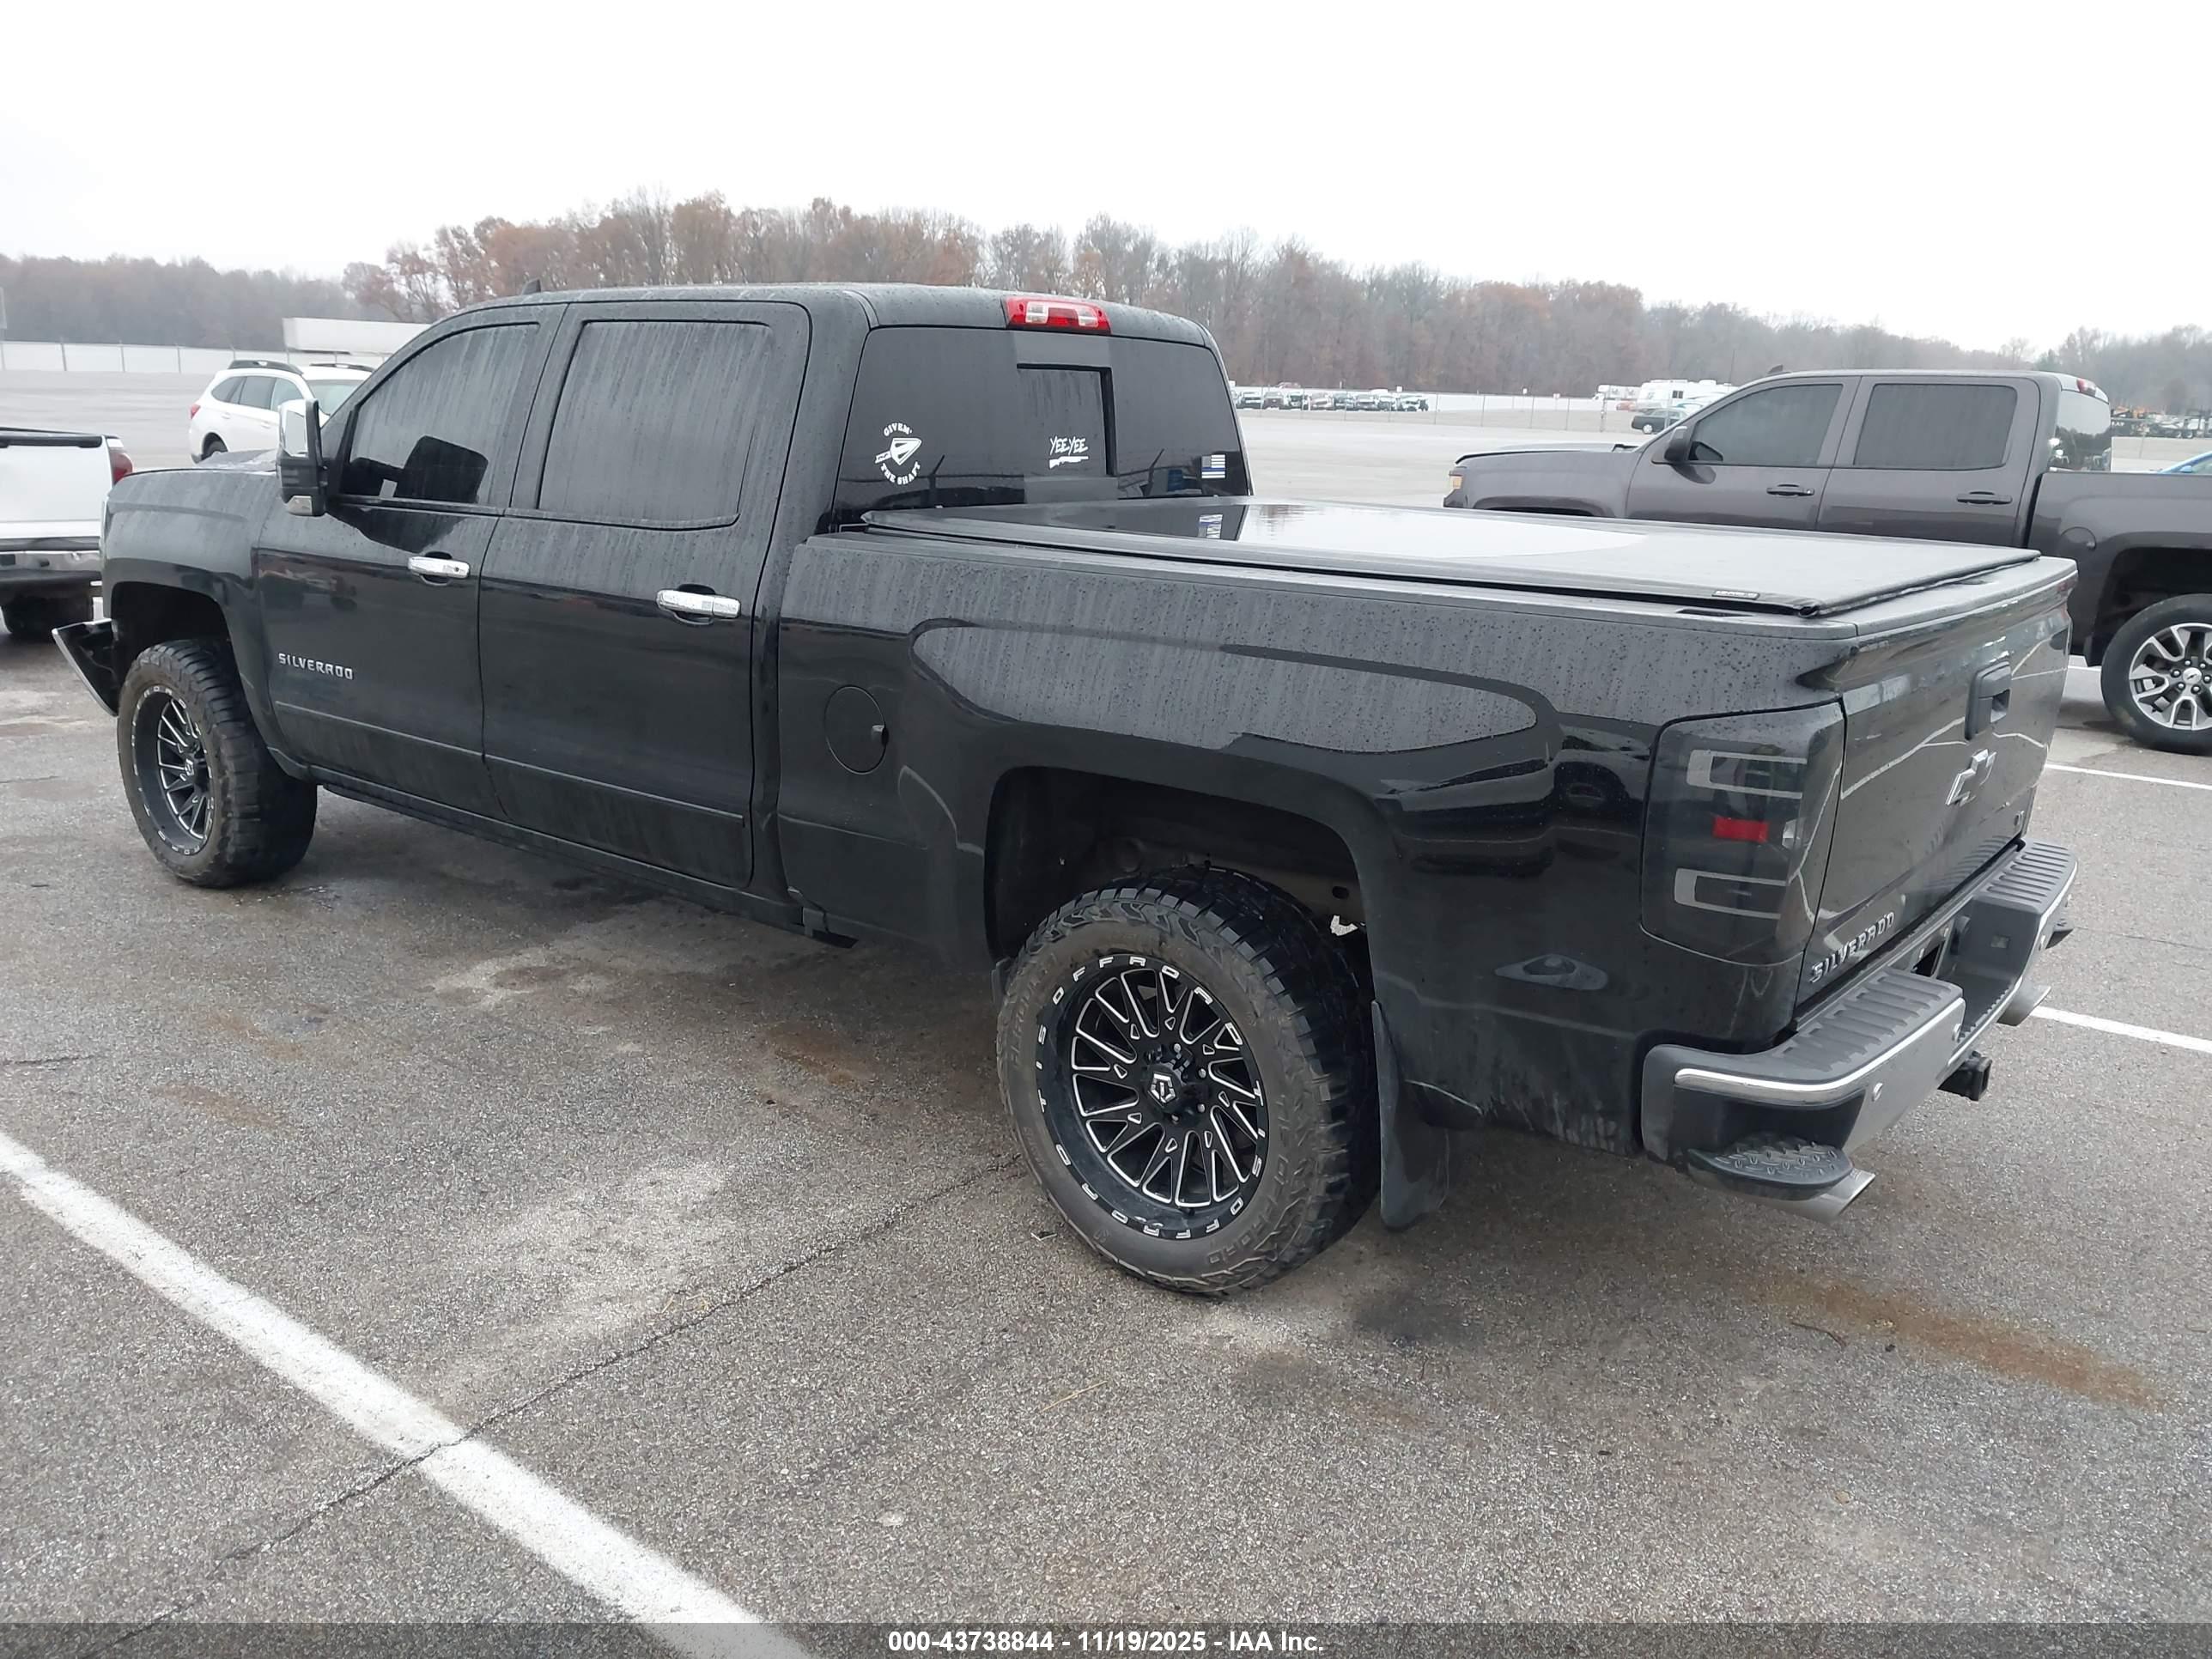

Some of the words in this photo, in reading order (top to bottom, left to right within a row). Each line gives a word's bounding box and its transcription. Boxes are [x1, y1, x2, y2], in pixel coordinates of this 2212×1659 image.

[880, 463, 896, 483] THE
[896, 461, 921, 485] SHAFT
[278, 653, 353, 680] SILVERADO
[1809, 911, 1894, 983] SILVERADO
